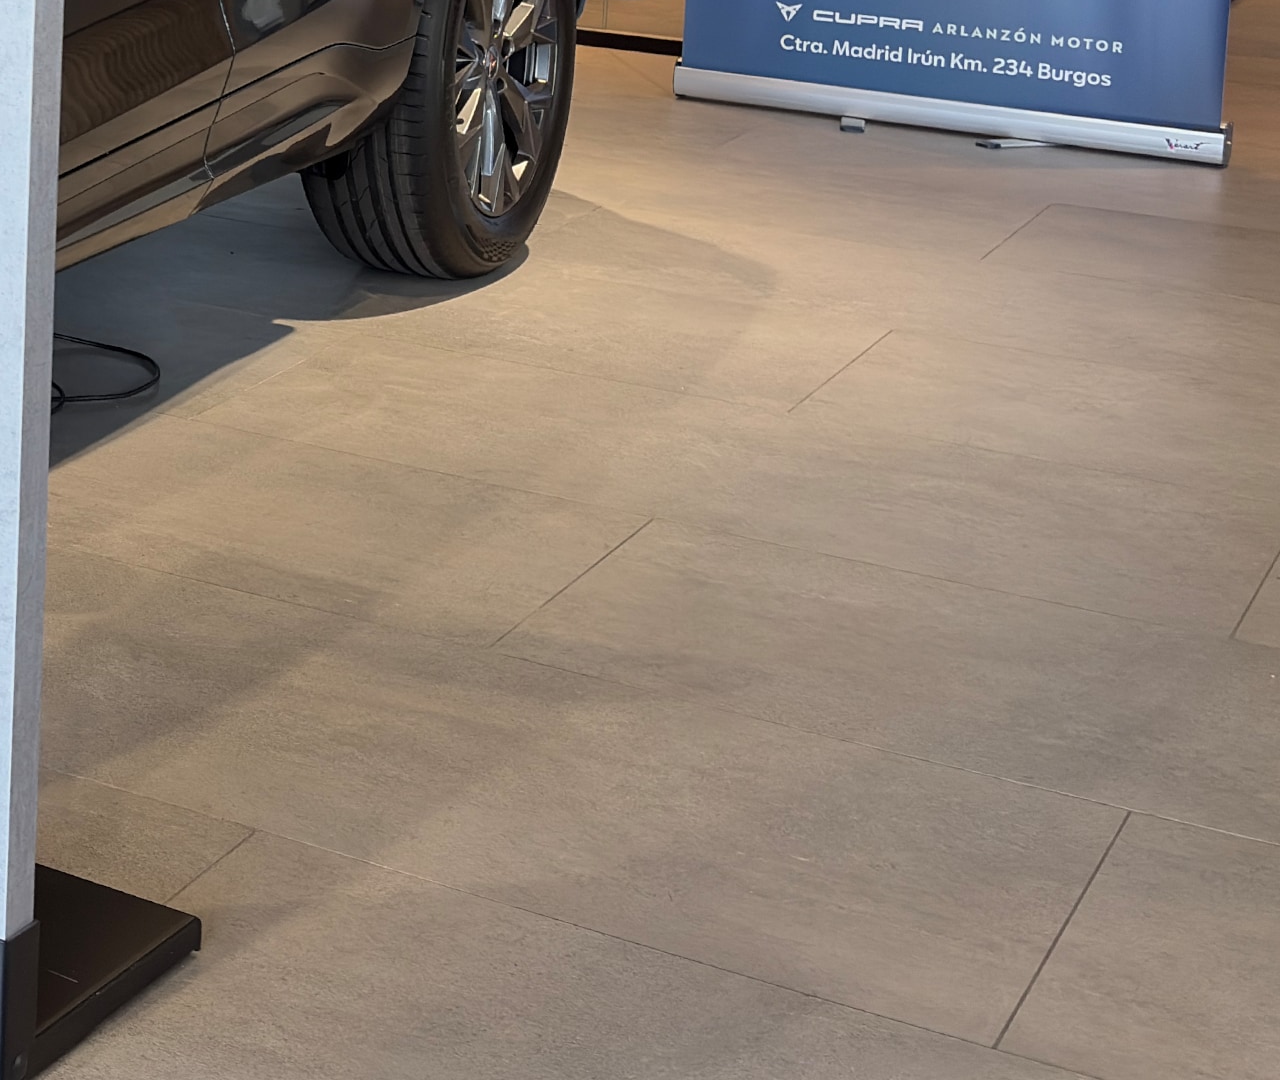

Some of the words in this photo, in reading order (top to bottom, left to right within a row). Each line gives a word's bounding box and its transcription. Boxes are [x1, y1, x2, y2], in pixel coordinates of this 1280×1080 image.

[812, 9, 924, 31] CUPRA
[932, 22, 1041, 45] ARLANZÓN
[1051, 35, 1124, 54] MOTOR
[780, 34, 828, 55] Ctra.
[832, 39, 903, 63] Madrid
[907, 47, 945, 68] Irún
[950, 53, 988, 73] Km.
[992, 57, 1033, 77] 234
[1037, 62, 1112, 87] Burgos
